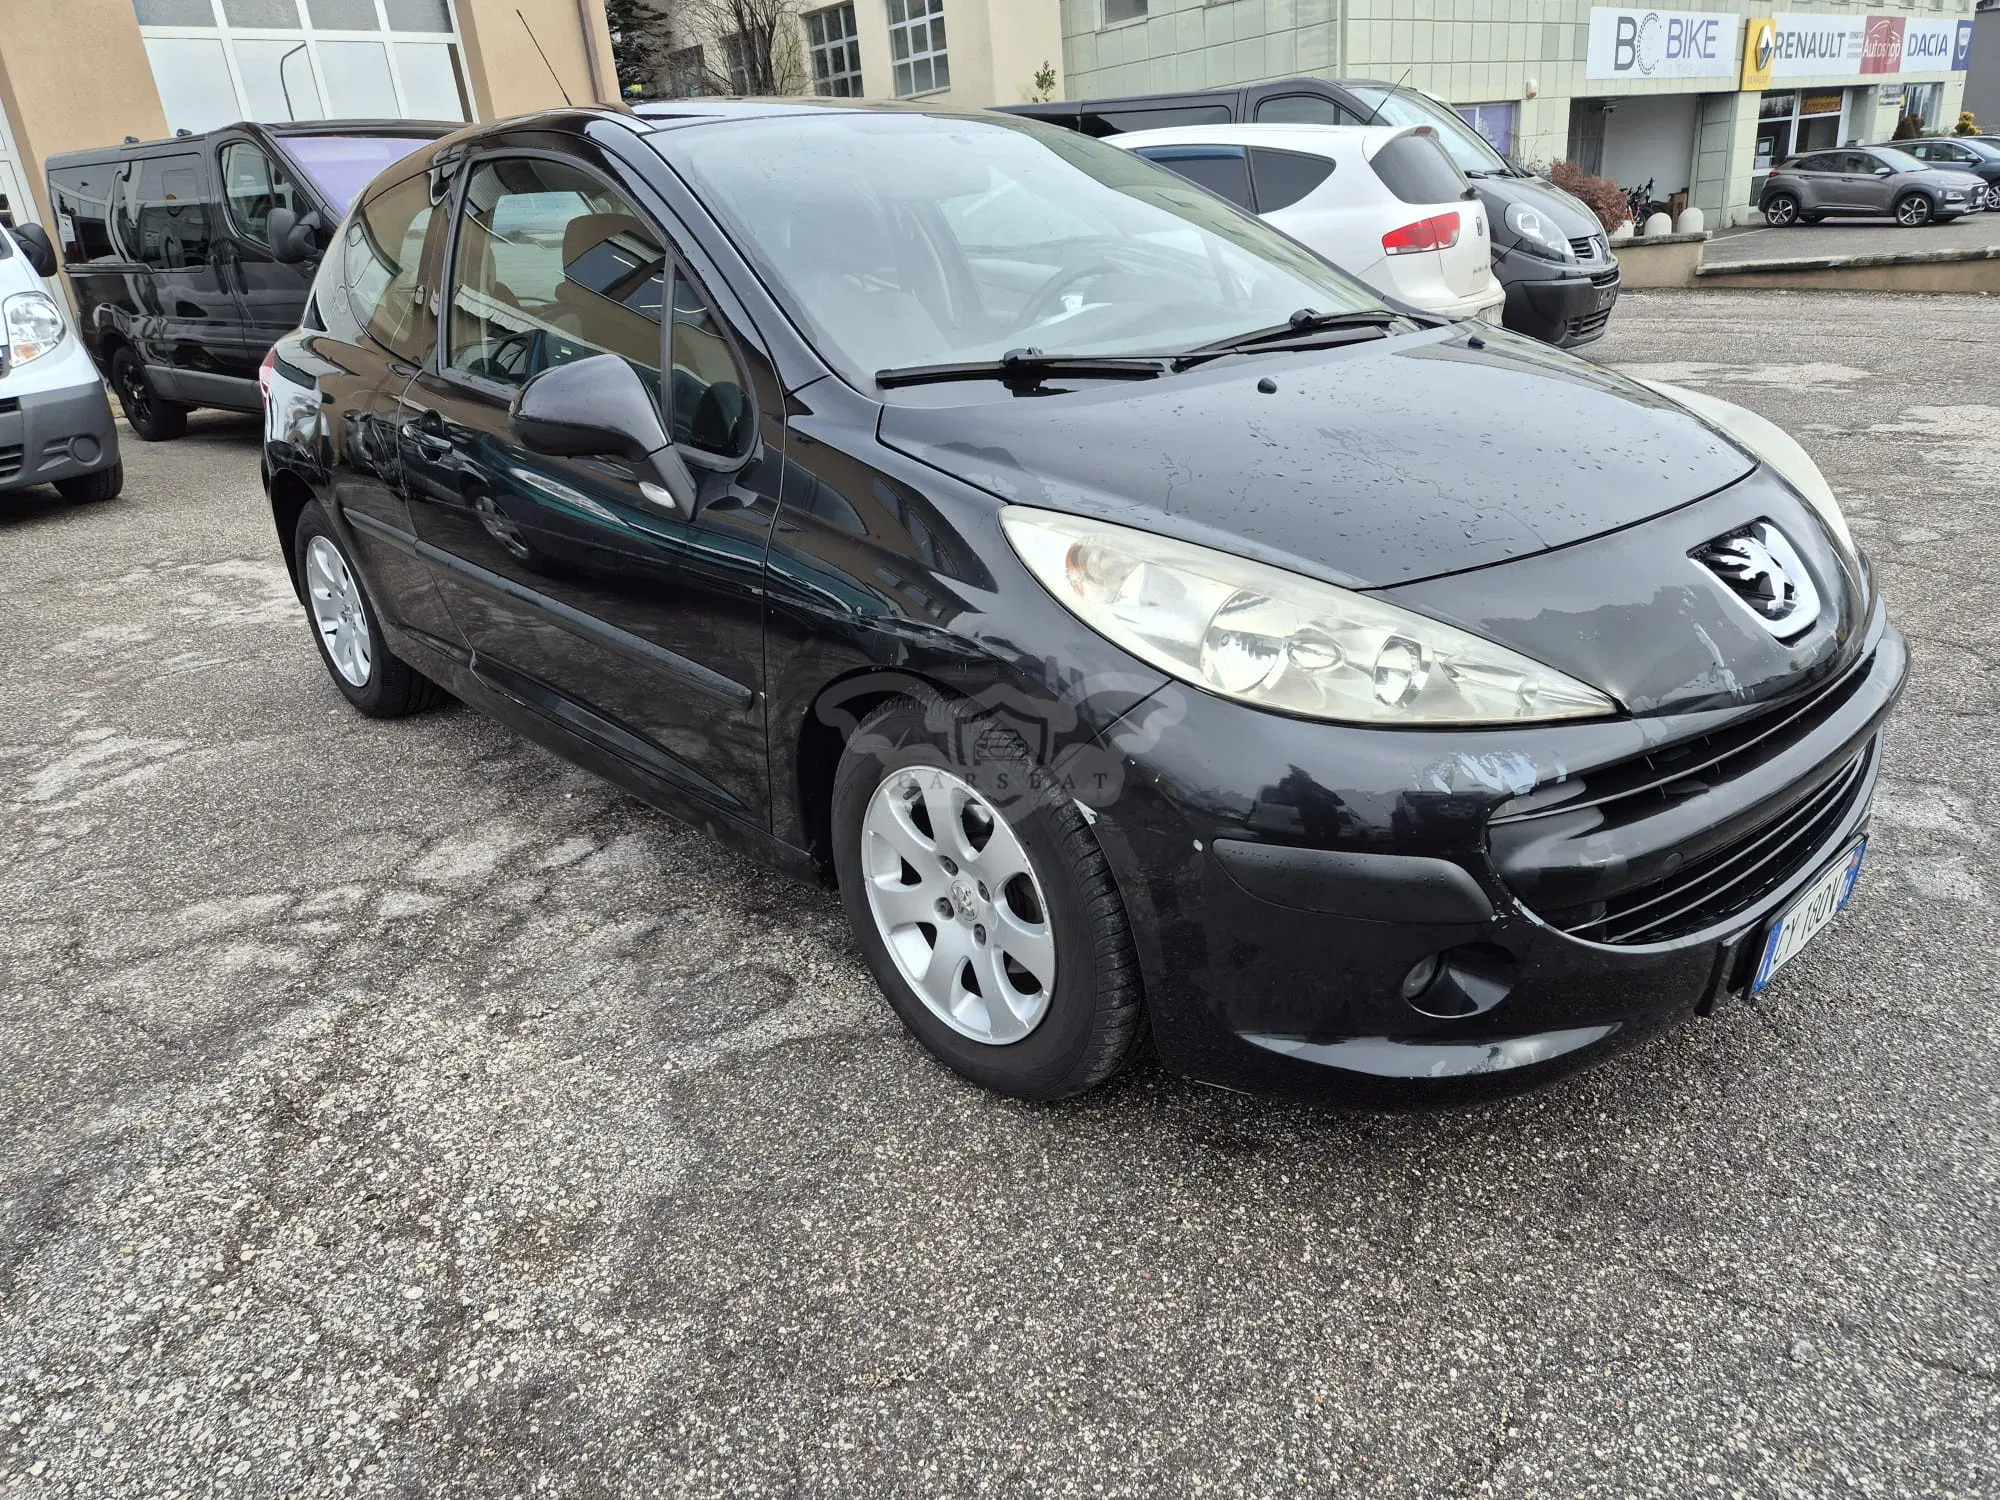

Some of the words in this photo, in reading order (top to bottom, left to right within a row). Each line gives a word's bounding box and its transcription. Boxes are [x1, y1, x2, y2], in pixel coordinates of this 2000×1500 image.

[1666, 18, 1719, 59] BIKE
[1773, 31, 1846, 59] RENAULT
[1907, 33, 1948, 56] DACIA
